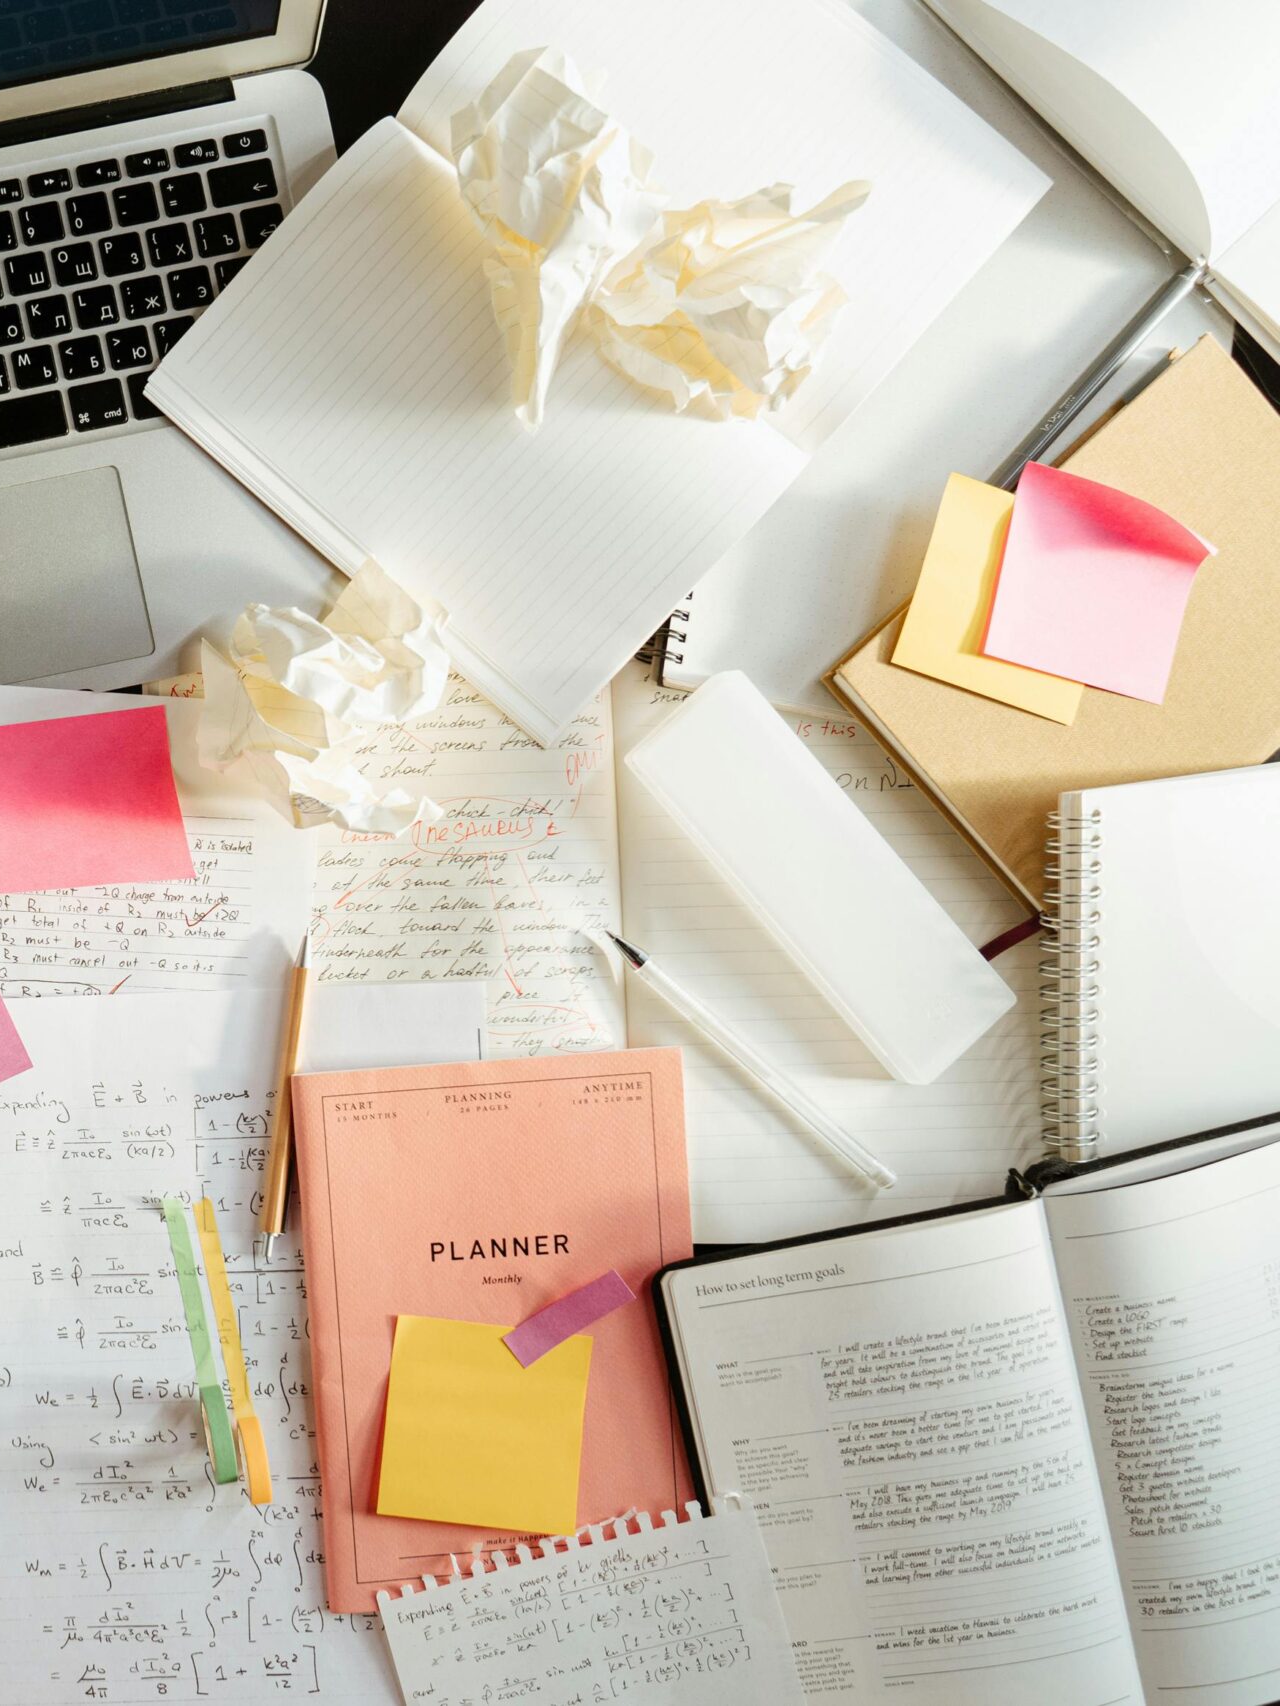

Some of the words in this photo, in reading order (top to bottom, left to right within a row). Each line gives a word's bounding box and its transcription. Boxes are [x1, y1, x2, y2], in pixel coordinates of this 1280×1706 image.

[27, 227, 35, 239] 9
[104, 241, 113, 254] P
[75, 262, 93, 276] Щ
[29, 271, 45, 286] Ш
[78, 295, 87, 307] L
[144, 295, 161, 310] Ж
[30, 303, 41, 317] K
[18, 353, 31, 367] M
[104, 408, 122, 419] cmd
[796, 720, 813, 737] is
[821, 720, 856, 738] this
[194, 1090, 249, 1109] powers
[334, 1101, 374, 1112] START
[444, 1091, 513, 1104] PLANNING
[583, 1081, 643, 1094] ANYTIME
[352, 1111, 398, 1122] MONTHS
[476, 1104, 510, 1113] PAGES
[430, 1234, 570, 1263] PLANNER
[481, 1274, 523, 1286] Monthly
[695, 1284, 724, 1297] How
[726, 1282, 738, 1292] to
[739, 1279, 756, 1290] set
[757, 1275, 785, 1289] long
[786, 1271, 813, 1282] term
[814, 1263, 846, 1281] goals
[1085, 1305, 1112, 1315] Create
[1087, 1317, 1114, 1327] Create
[716, 1361, 739, 1371] WHAT
[732, 1439, 751, 1447] WHY
[486, 1537, 507, 1545] make
